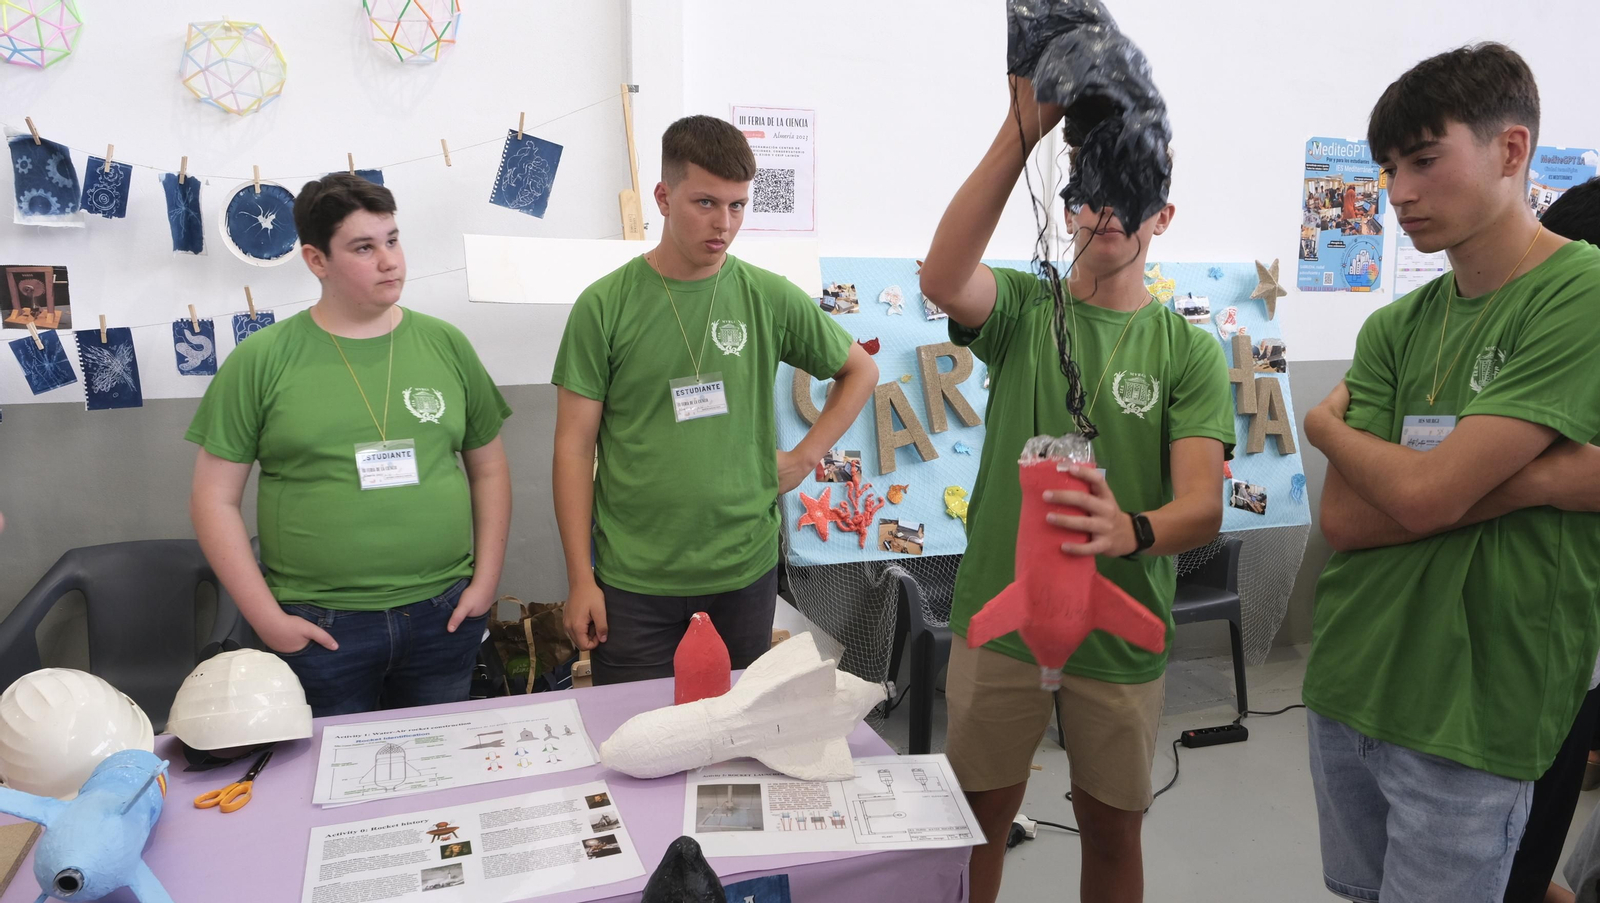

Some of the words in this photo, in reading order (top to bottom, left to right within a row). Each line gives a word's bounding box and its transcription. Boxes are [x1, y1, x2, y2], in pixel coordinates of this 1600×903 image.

[748, 116, 765, 126] FERIA
[767, 117, 774, 126] DE
[776, 117, 784, 127] LA
[785, 118, 808, 128] CIENCIA
[773, 131, 795, 140] Almería
[1312, 141, 1367, 158] MediteGPT
[1540, 154, 1577, 165] MediteGPT
[676, 383, 721, 397] ESTUDIANTE
[431, 722, 472, 730] construction
[355, 736, 382, 744] Rocket
[325, 830, 358, 838] Activity
[371, 823, 399, 831] Rocket
